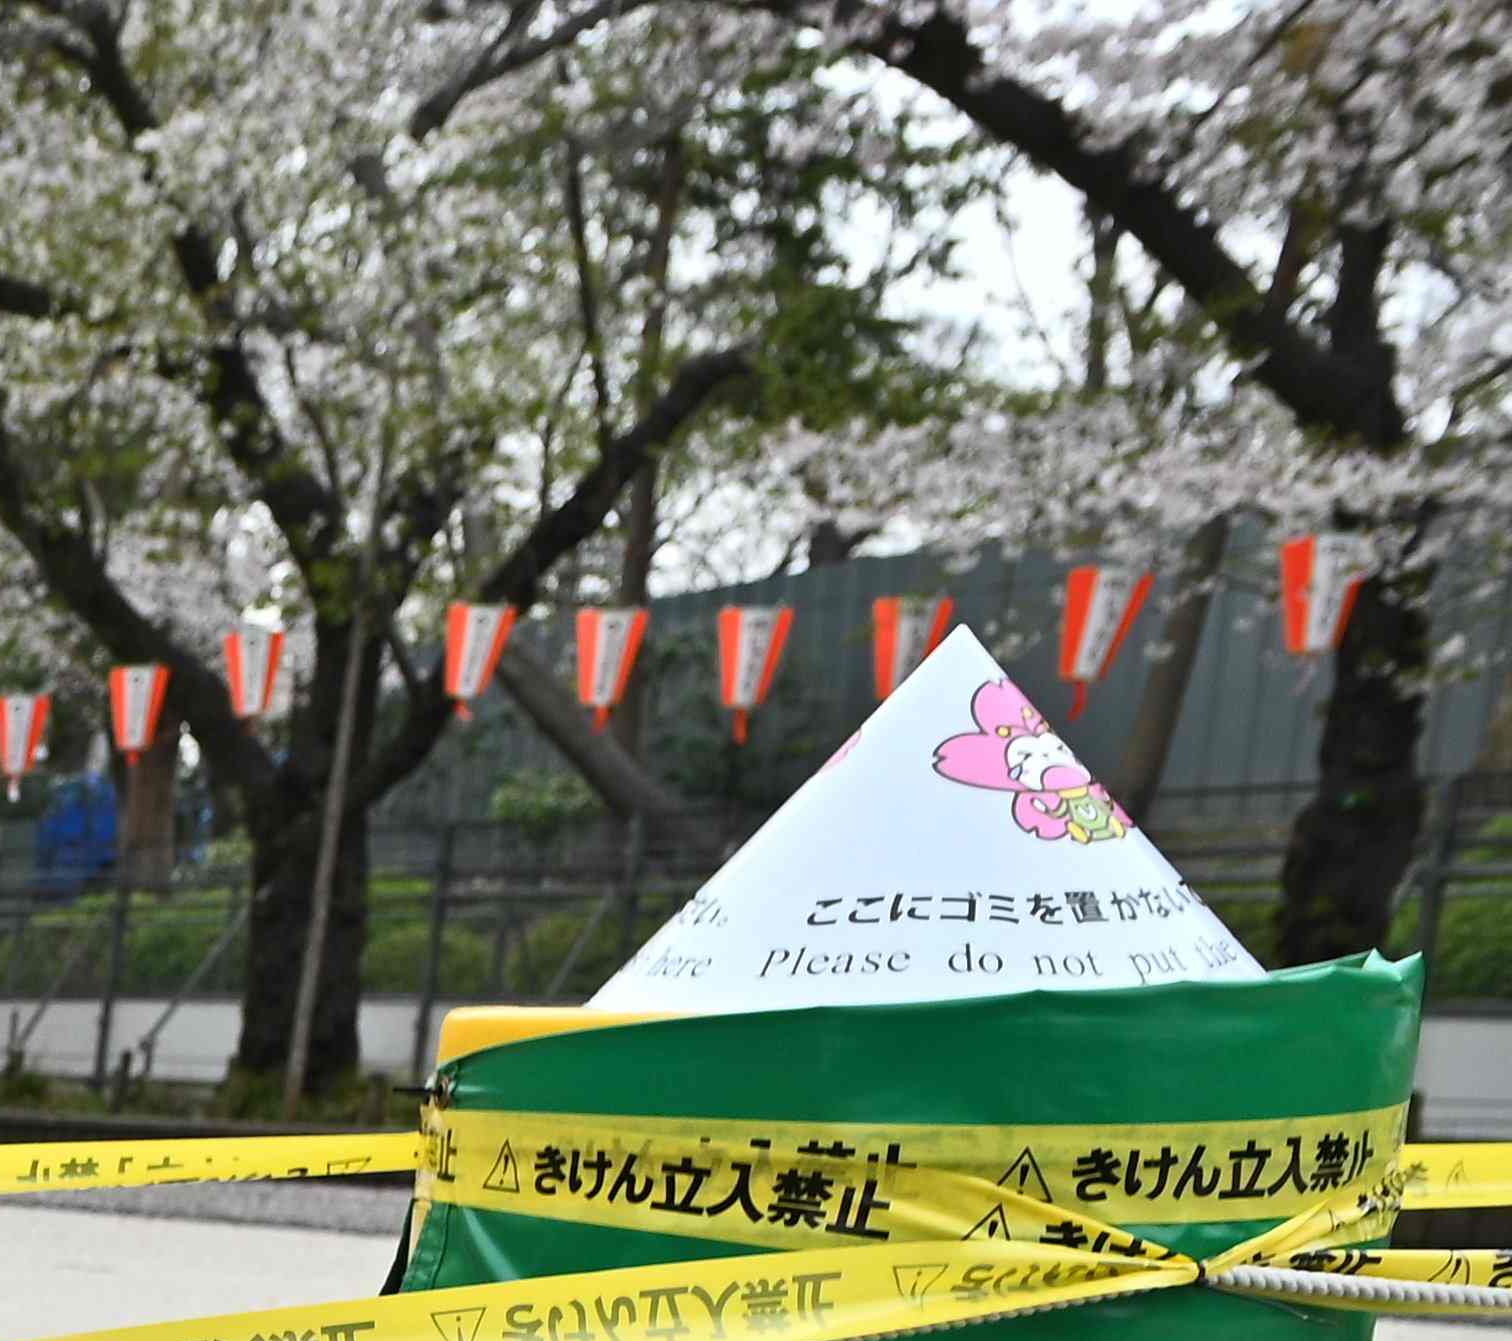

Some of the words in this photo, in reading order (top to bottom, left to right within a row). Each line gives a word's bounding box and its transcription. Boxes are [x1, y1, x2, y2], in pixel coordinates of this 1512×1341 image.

[758, 946, 912, 978] Please
[947, 942, 1004, 974] do
[1031, 949, 1104, 976] not
[1128, 943, 1188, 985] put
[534, 1144, 892, 1241] きけん立入禁止
[1070, 1128, 1375, 1200] きけん立入禁止
